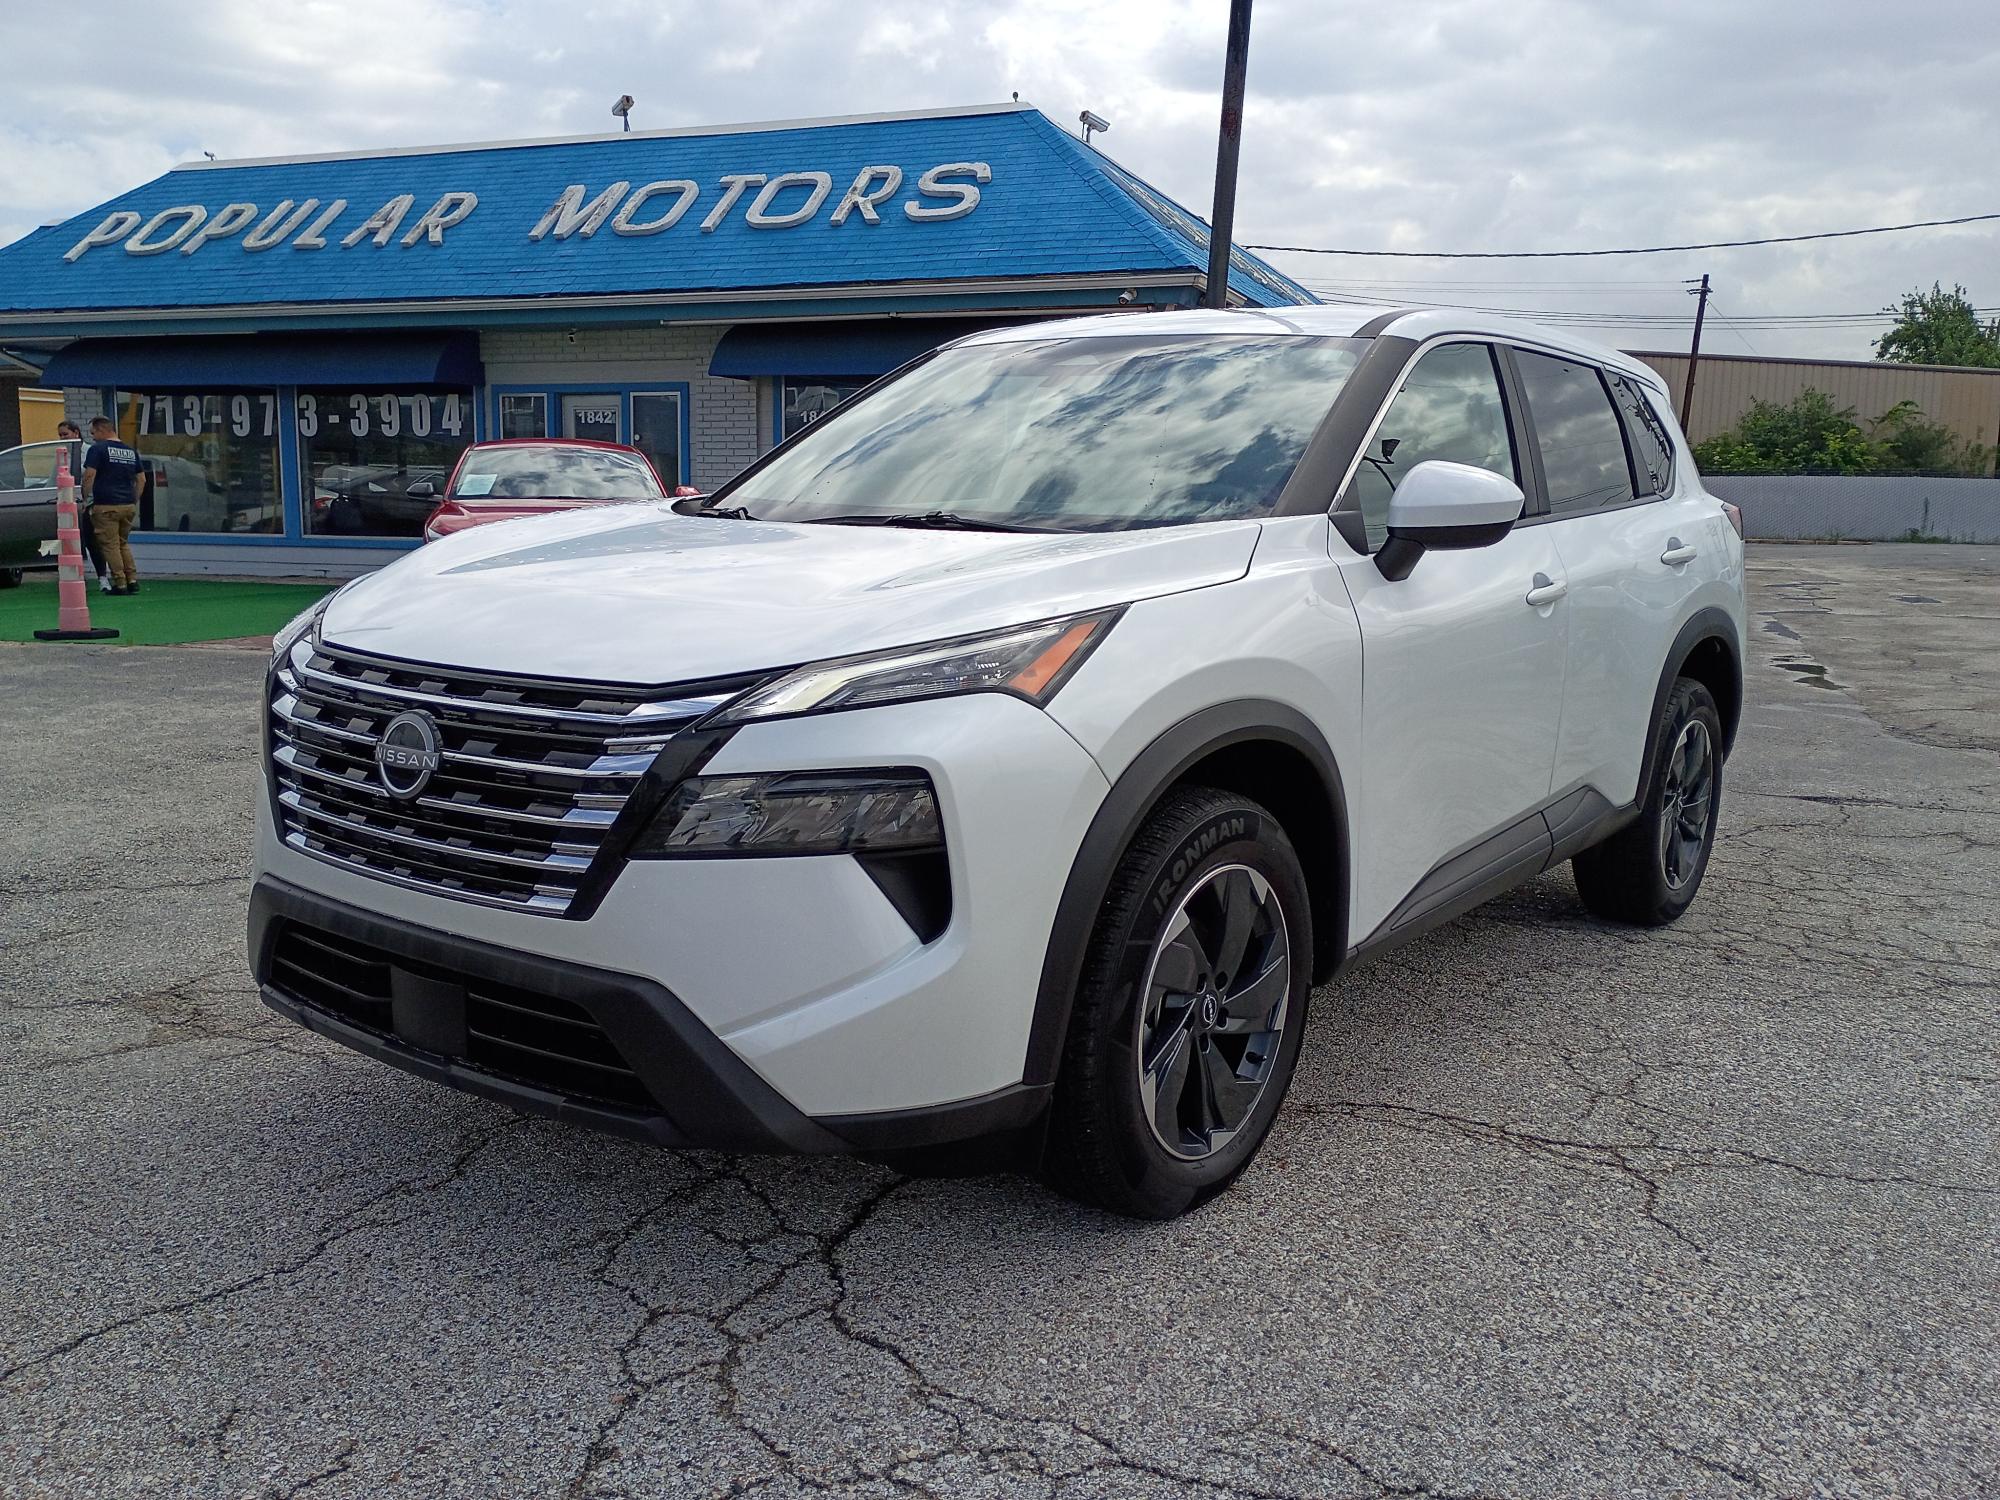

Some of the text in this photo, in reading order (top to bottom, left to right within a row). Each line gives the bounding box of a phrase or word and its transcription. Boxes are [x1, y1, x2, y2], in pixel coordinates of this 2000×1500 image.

[63, 162, 992, 262] POPULAR MOTORS
[578, 411, 613, 424] 1842
[376, 745, 437, 768] NISSAN
[1152, 817, 1245, 915] IRONMAN
